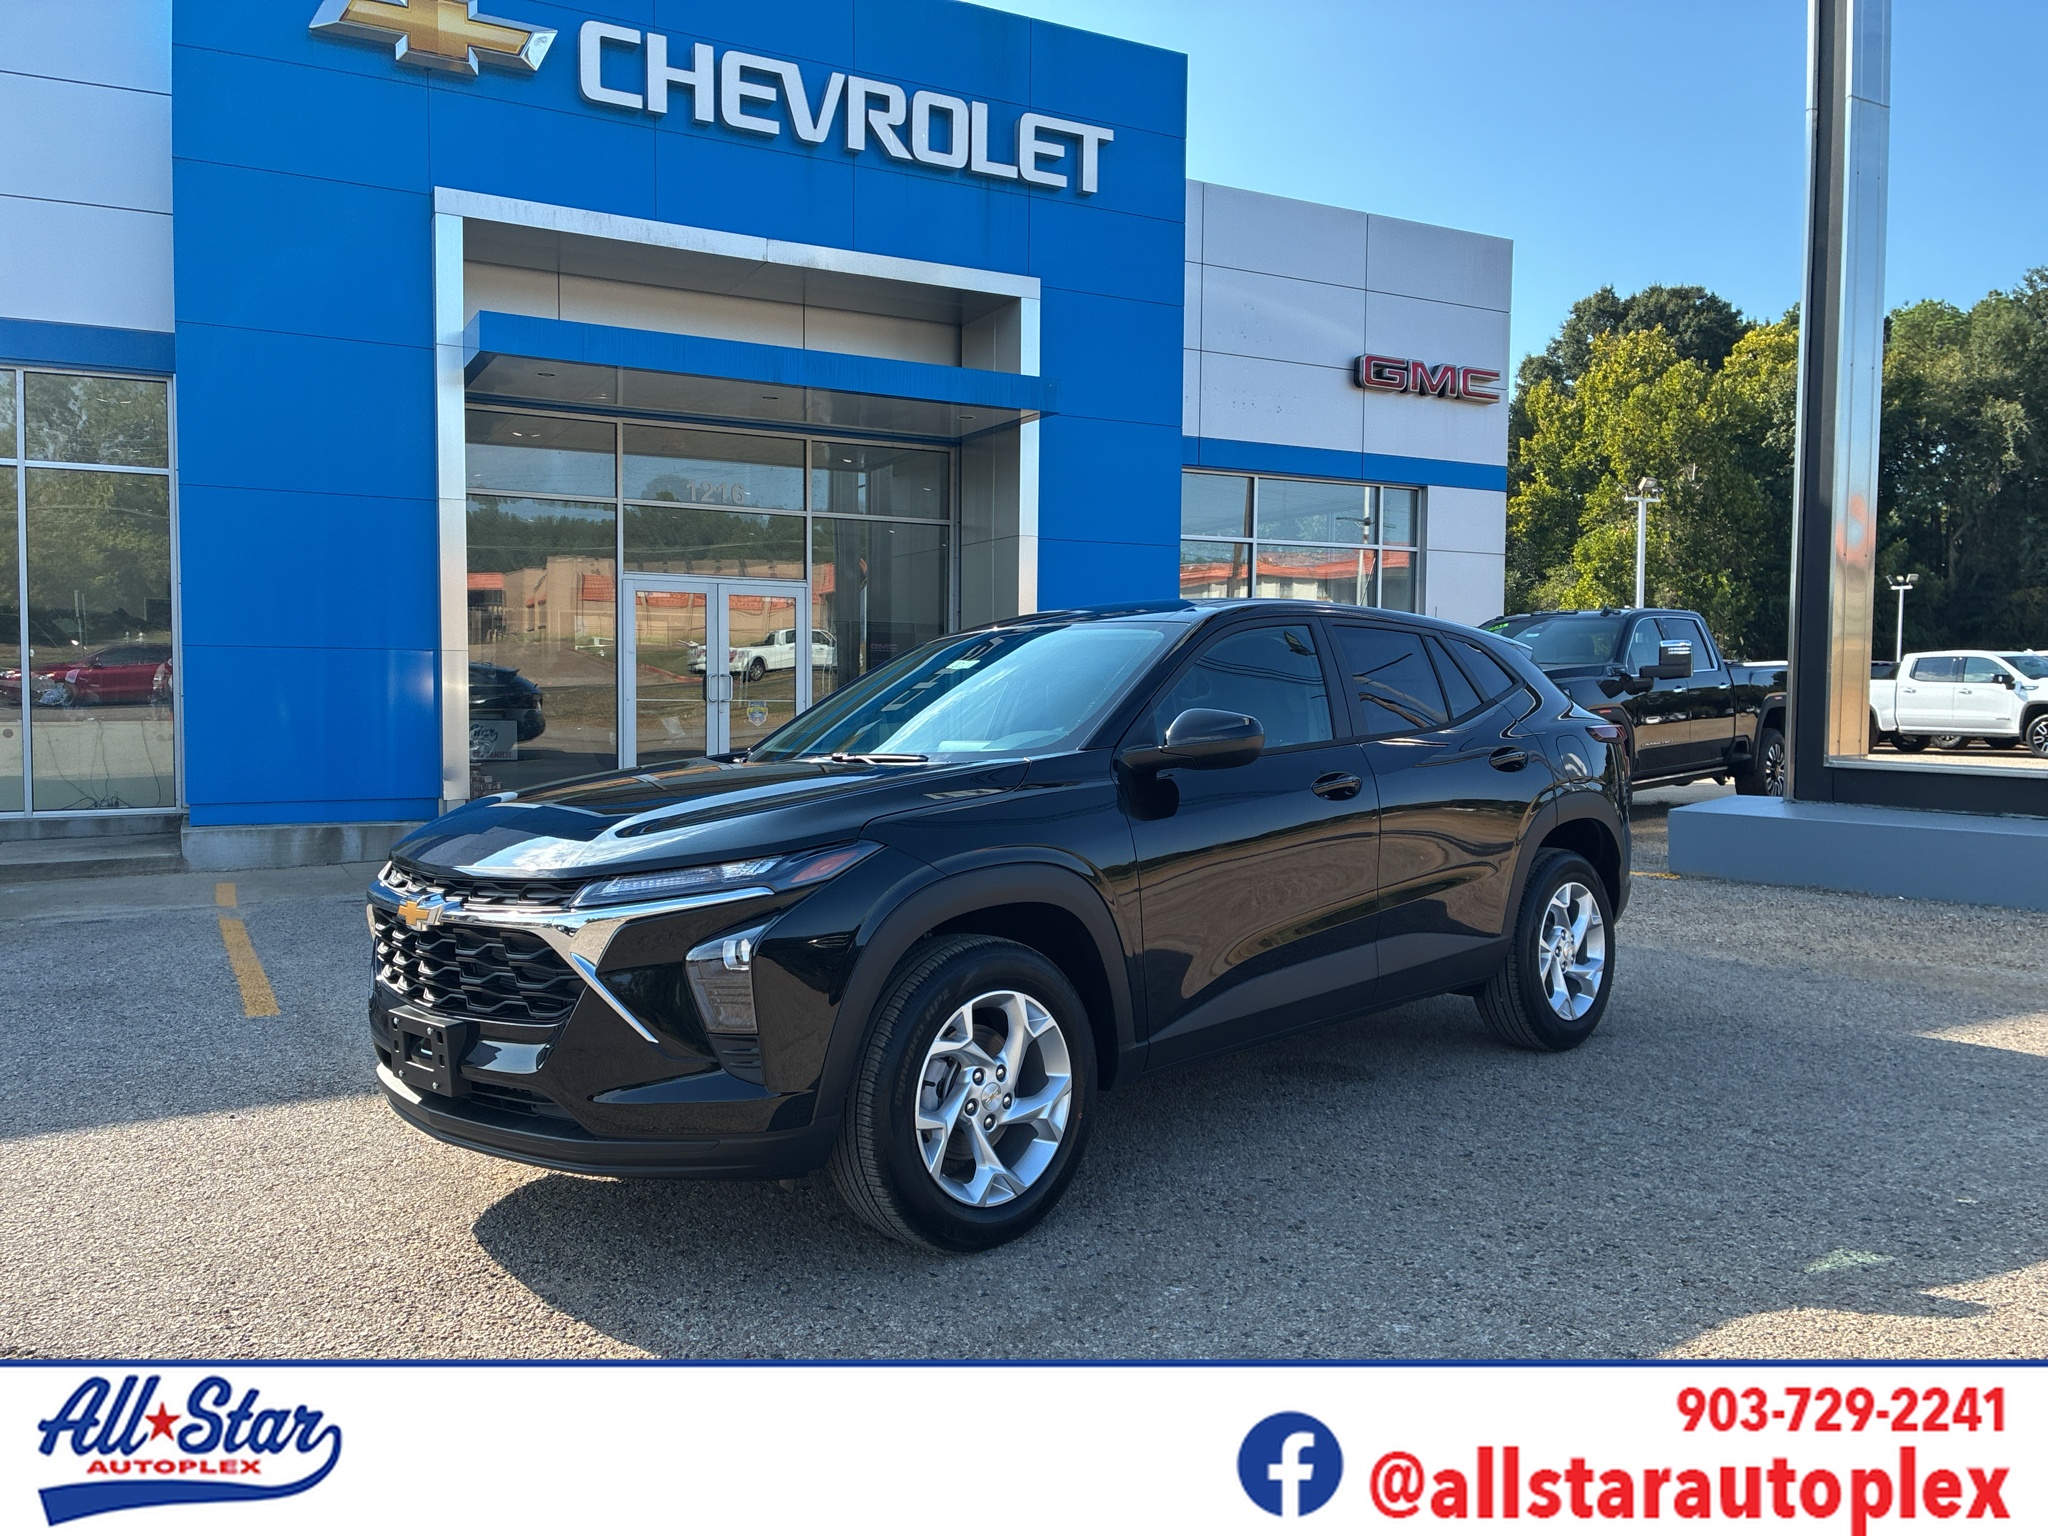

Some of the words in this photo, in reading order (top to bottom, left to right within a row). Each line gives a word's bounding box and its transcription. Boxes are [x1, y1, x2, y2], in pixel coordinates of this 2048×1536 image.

[578, 19, 1115, 196] CHEVROLET
[1354, 353, 1502, 405] GMC
[686, 479, 746, 505] 1216
